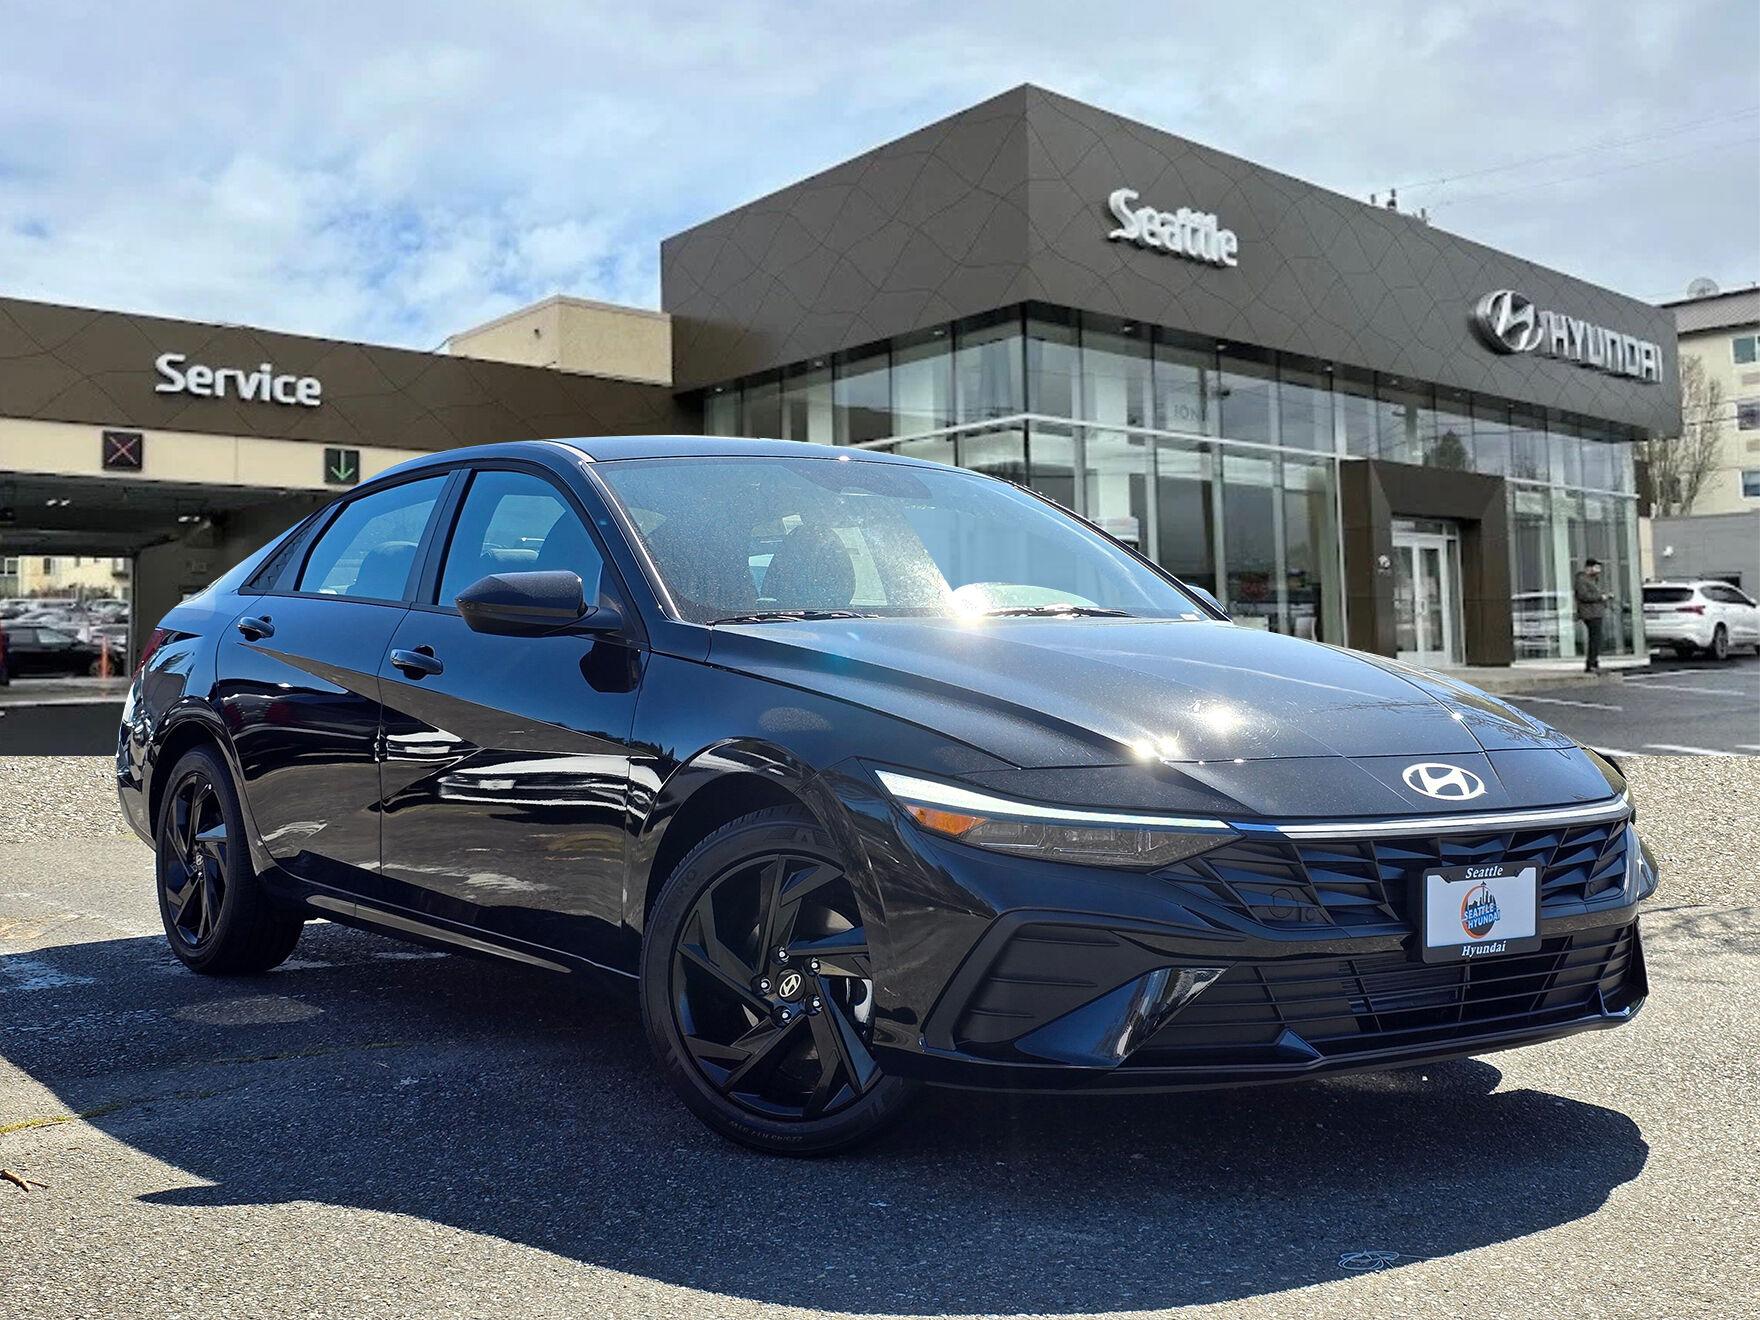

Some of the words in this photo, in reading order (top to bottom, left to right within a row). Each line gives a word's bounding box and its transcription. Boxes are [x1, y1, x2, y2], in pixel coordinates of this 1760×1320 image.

[1109, 188, 1238, 266] Seattle
[1542, 311, 1663, 383] HYUNDAI
[155, 353, 322, 406] Service
[1465, 865, 1504, 879] Seattle
[1464, 902, 1494, 920] SEATTLE
[1467, 909, 1501, 929] HYUNDAI
[1461, 940, 1507, 958] Hyundai
